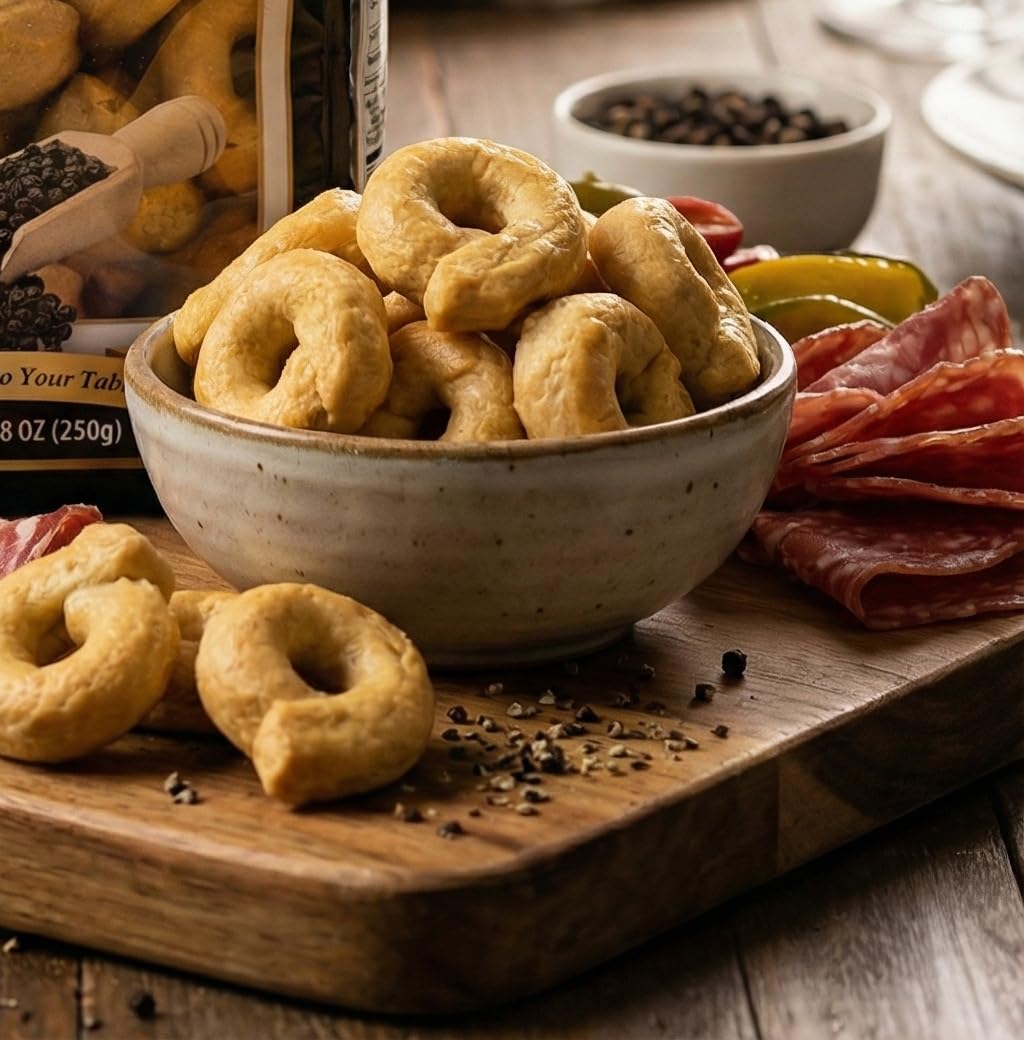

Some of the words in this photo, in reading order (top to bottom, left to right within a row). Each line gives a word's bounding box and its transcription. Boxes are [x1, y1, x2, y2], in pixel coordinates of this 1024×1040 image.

[20, 367, 75, 387] Your
[80, 370, 125, 393] Tab
[18, 419, 46, 441] OZ
[52, 419, 122, 446] (250g)
